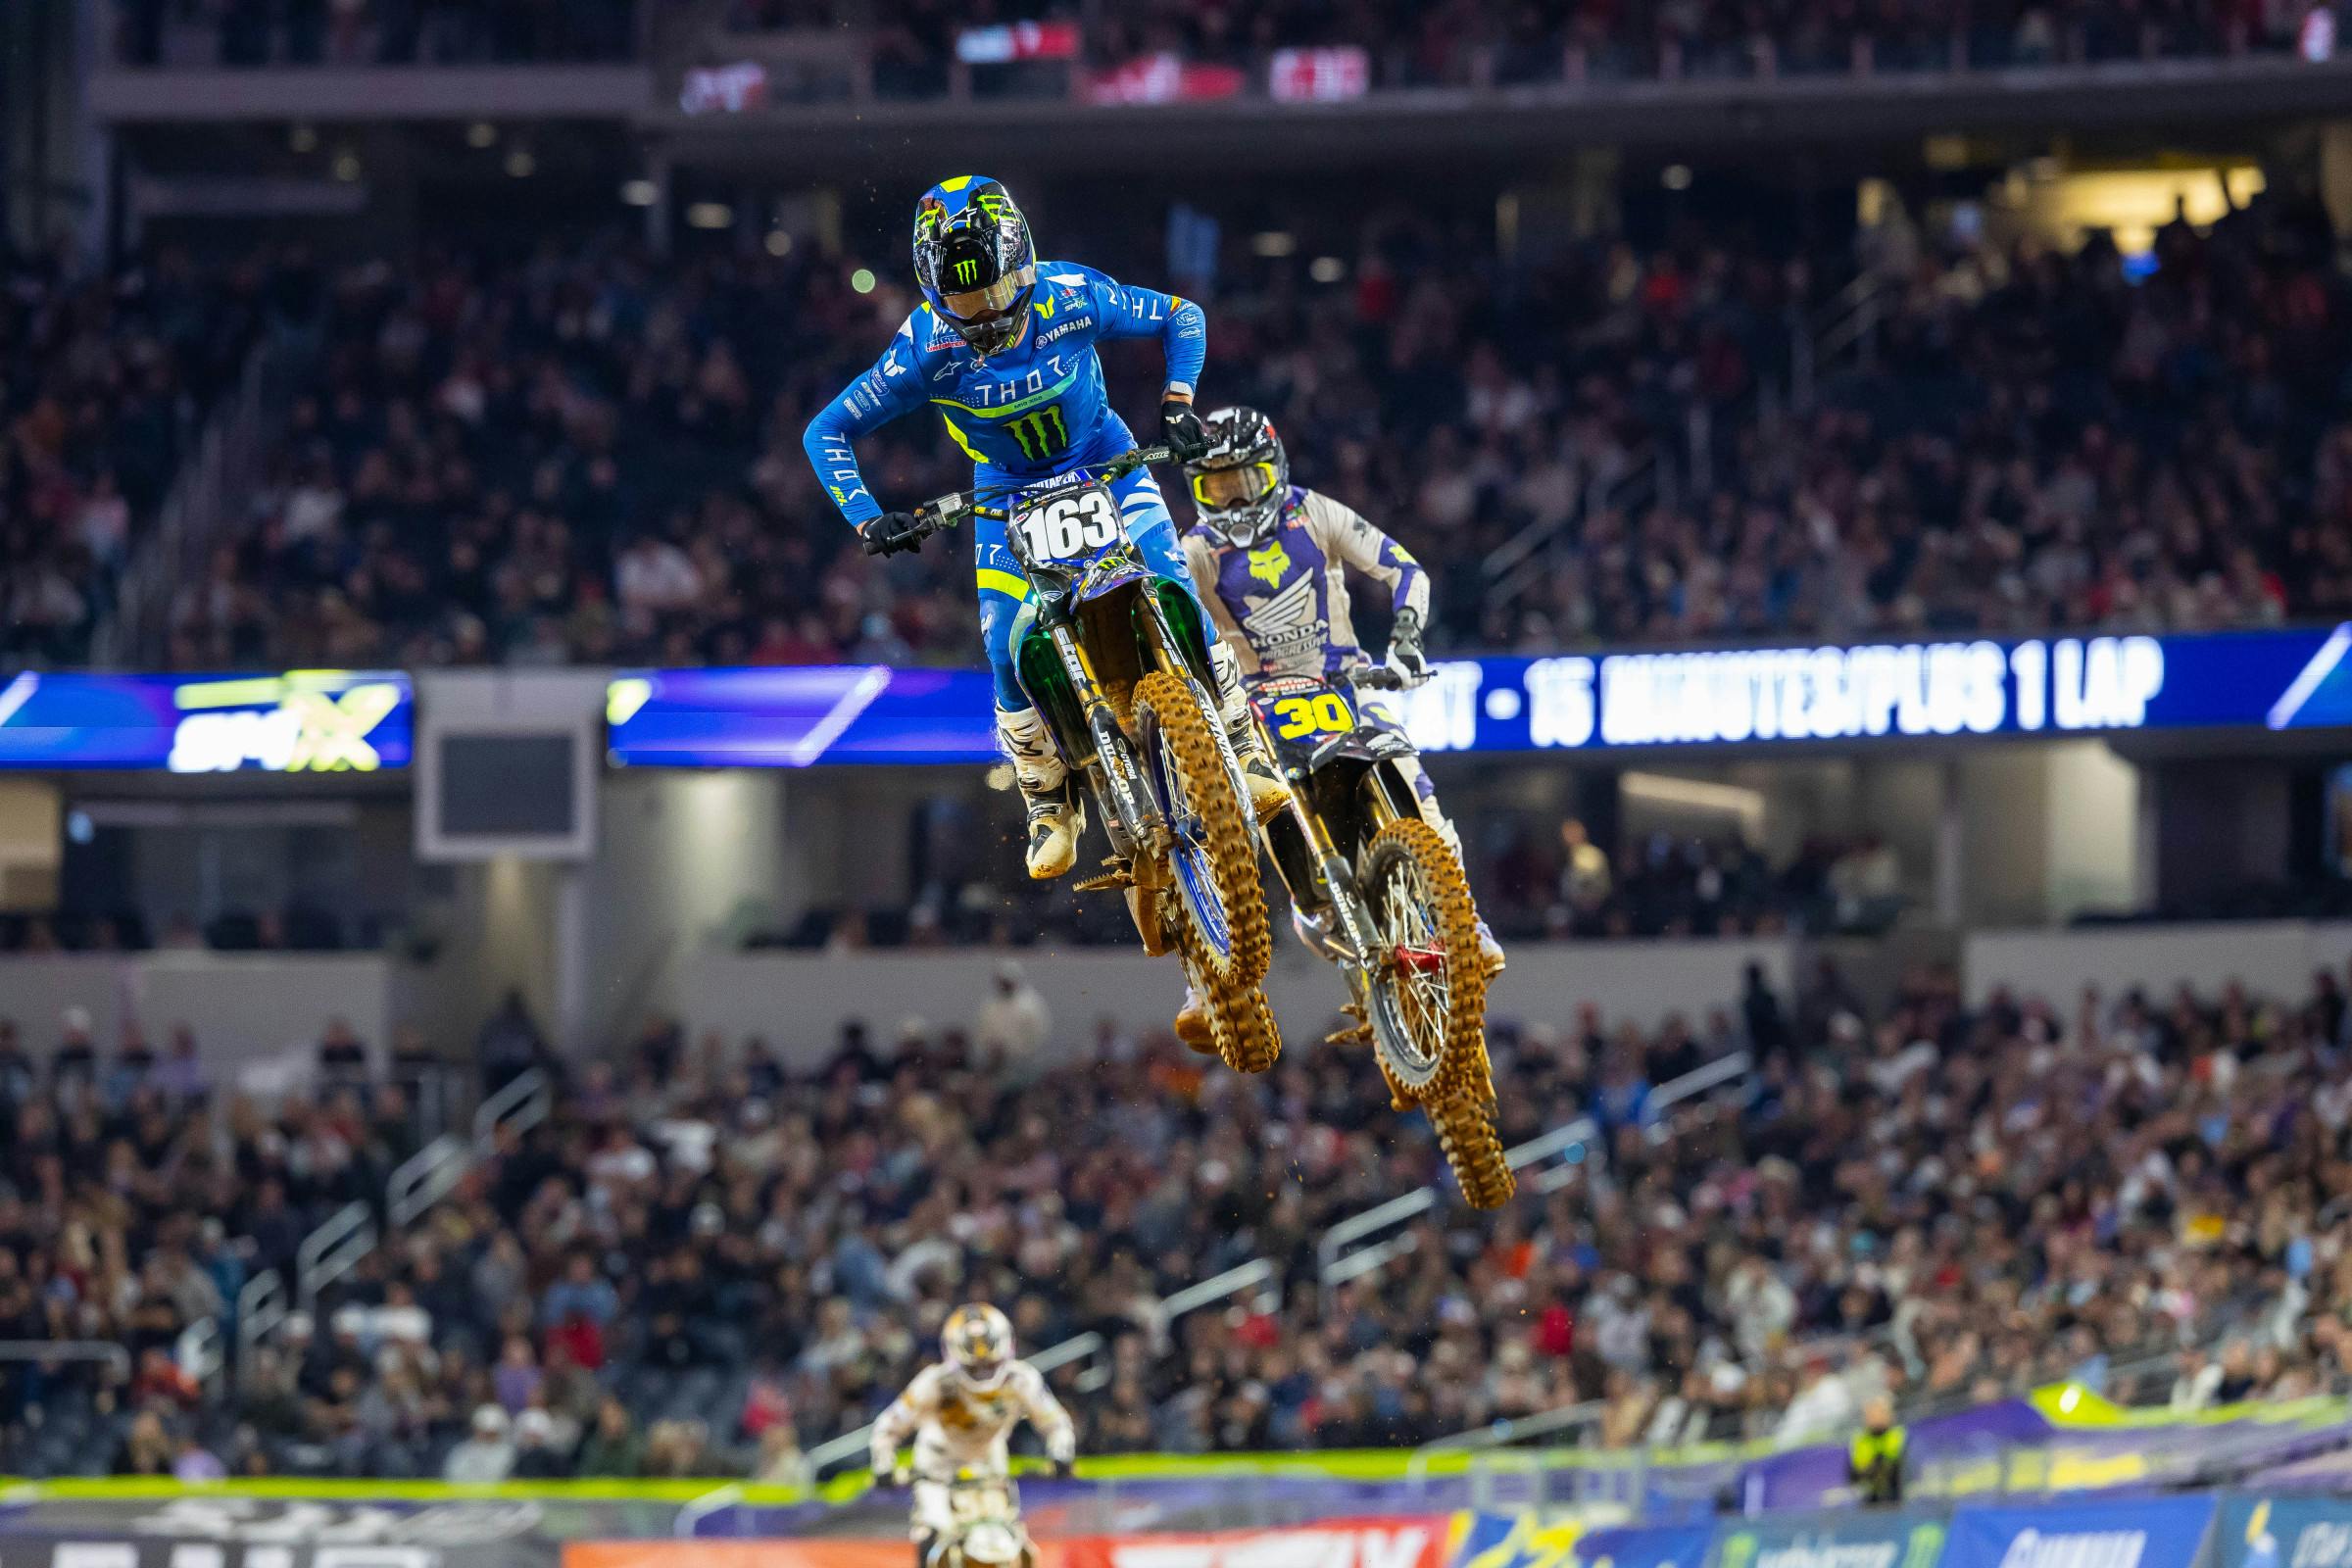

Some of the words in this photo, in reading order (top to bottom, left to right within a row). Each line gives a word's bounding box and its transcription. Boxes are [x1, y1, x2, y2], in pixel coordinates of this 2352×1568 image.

[1046, 316, 1093, 342] YAMAHA
[1020, 491, 1118, 563] 163
[1250, 619, 1329, 649] HONDA
[1523, 657, 1596, 748] 15
[2010, 639, 2048, 730] 1
[2054, 636, 2165, 729] LAP
[1273, 693, 1354, 741] 30
